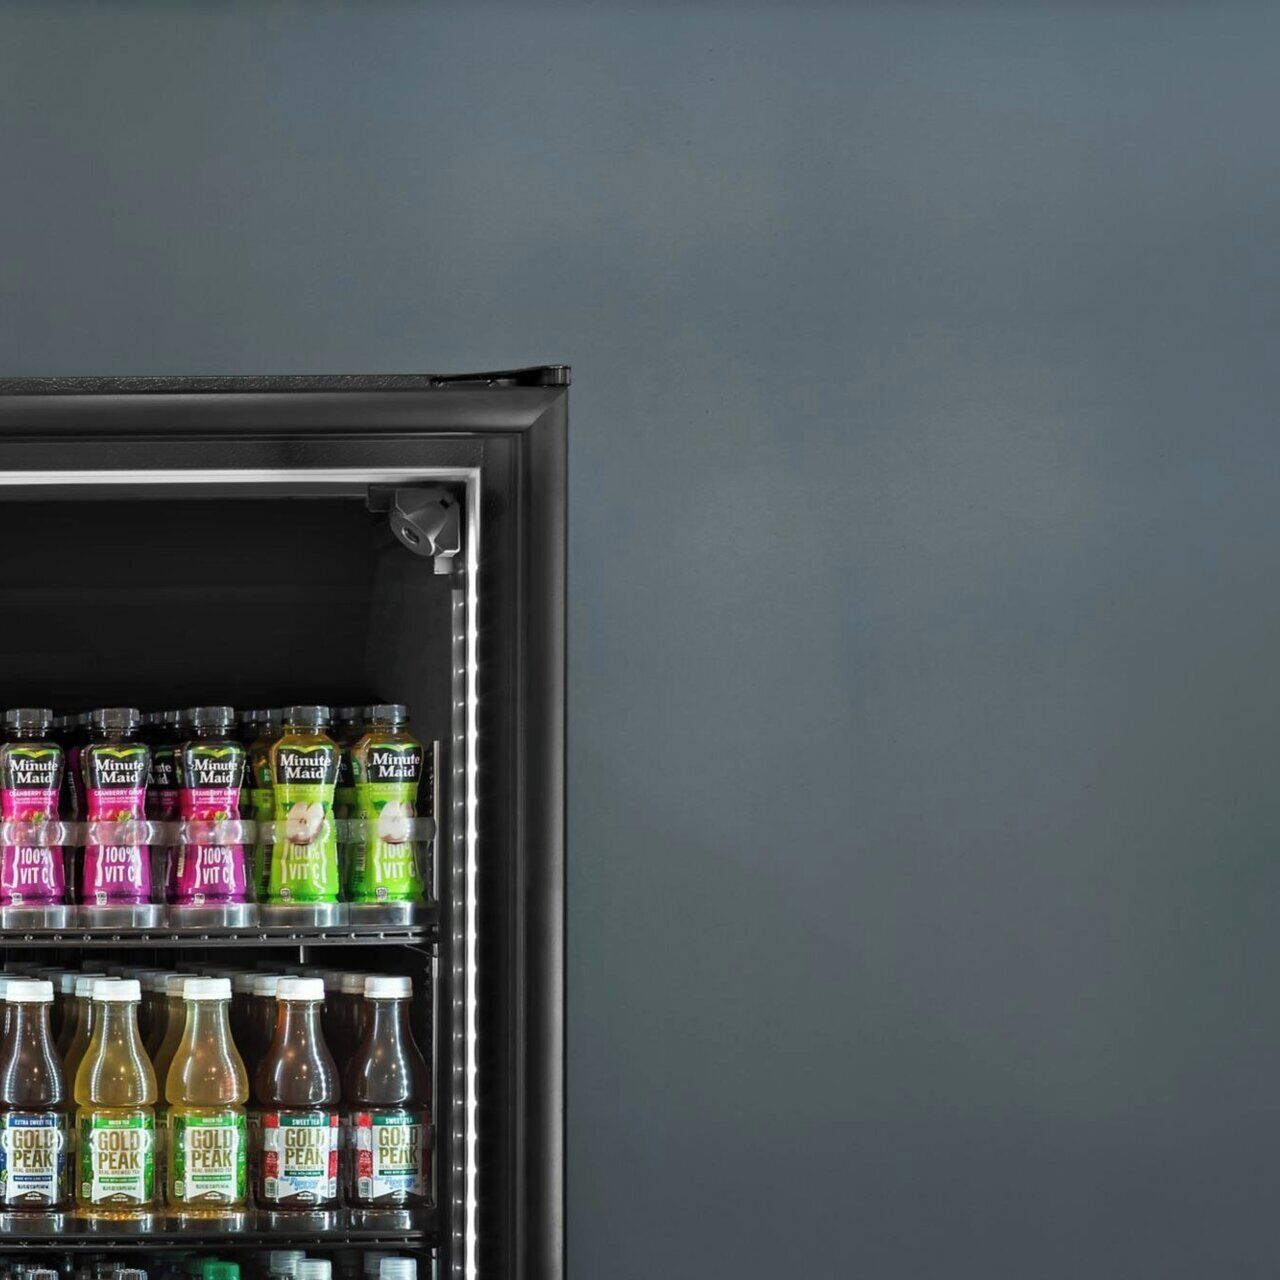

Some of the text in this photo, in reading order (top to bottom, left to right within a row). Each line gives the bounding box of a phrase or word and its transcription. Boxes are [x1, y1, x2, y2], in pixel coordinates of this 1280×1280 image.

[11, 759, 58, 784] Minute Maid
[96, 758, 144, 783] Minute Maid
[194, 758, 237, 783] Minute Maid
[279, 754, 331, 779] Minute Maid
[372, 752, 420, 778] Minute Maid
[12, 1130, 54, 1149] GOLD
[97, 1130, 139, 1150] GOLD
[191, 1129, 233, 1168] GOLD PEAK
[284, 1128, 325, 1165] GOLD PEAK
[12, 1150, 53, 1168] PEAK
[97, 1151, 140, 1169] PEAK
